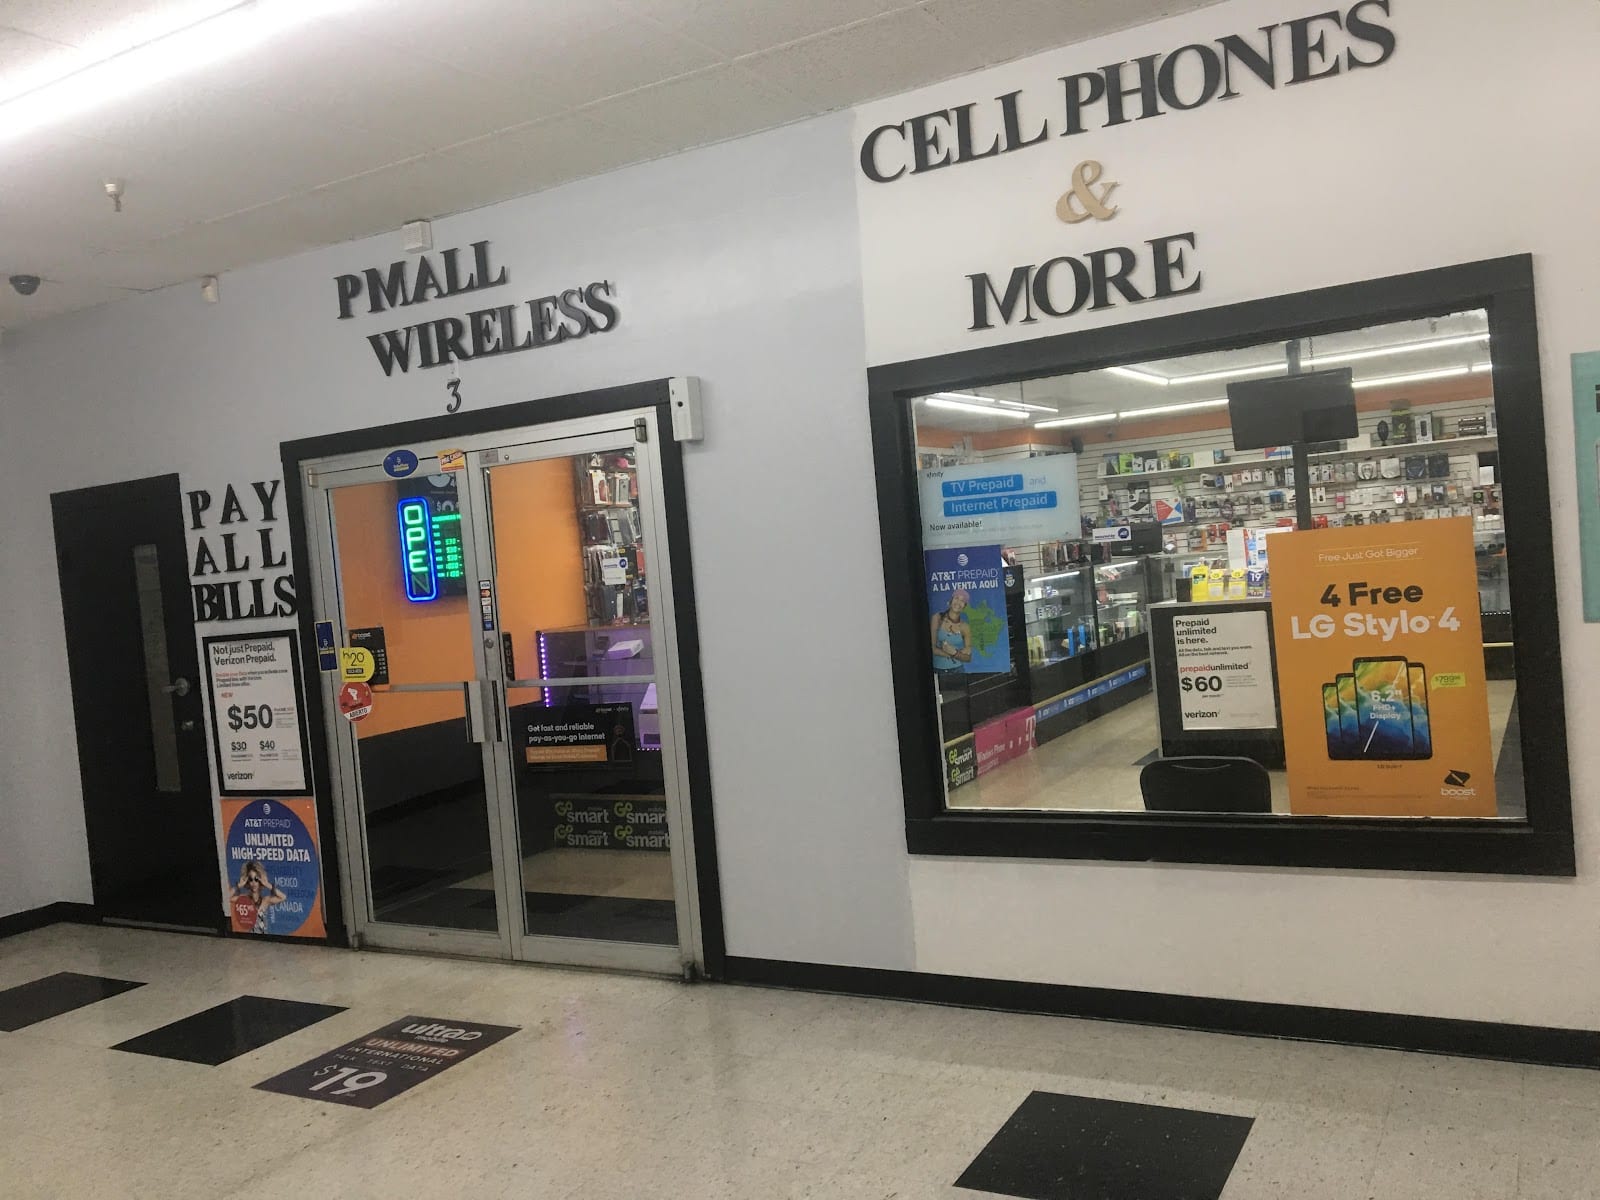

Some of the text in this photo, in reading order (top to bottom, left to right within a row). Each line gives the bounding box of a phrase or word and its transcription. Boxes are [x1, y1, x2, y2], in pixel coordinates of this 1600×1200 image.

[860, 0, 1396, 183] CELL PHONES
[1055, 159, 1120, 224] &
[334, 240, 507, 319] PMALL
[964, 231, 1203, 332] MORE
[366, 279, 619, 376] WIRELESS
[446, 378, 462, 413] 3
[950, 476, 1047, 494] TV Prepaid and
[186, 480, 281, 530] PAY
[951, 493, 1048, 513] Internet Prepaid
[929, 520, 982, 531] Now available!
[192, 528, 287, 576] ALL
[403, 504, 431, 595] OPEN
[1318, 547, 1418, 562] Free Just Got Bigger
[931, 567, 999, 581] AT&T PREPAID
[1250, 573, 1261, 582] 19
[933, 578, 999, 592] A LA VENTA AQUÍ
[191, 574, 299, 622] BILLS
[1320, 582, 1424, 607] 4 Free
[1175, 618, 1209, 627] Prepaid
[1290, 606, 1461, 642] LG Stylo 4
[1176, 627, 1217, 636] unlimited
[1185, 636, 1208, 644] here.
[212, 641, 275, 656] Not just Prepaid.
[214, 653, 277, 666] Verizon Prepaid.
[1179, 663, 1249, 673] prepaidunlimited
[1181, 675, 1222, 692] $60
[227, 704, 273, 732] $50
[1185, 710, 1218, 719] verizon
[1369, 711, 1401, 720] Display
[541, 724, 554, 732] fast
[569, 722, 595, 730] reliable
[231, 740, 275, 751] $30 $40
[528, 735, 578, 744] pay-as-you-go
[226, 771, 253, 780] verizon
[1440, 787, 1476, 796] boost
[567, 809, 609, 823] smart
[614, 802, 666, 824] Go smar
[244, 818, 291, 828] AT&T PREPAID
[244, 833, 294, 847] UNLIMITED
[567, 832, 609, 846] smart
[614, 825, 633, 840] Go
[232, 846, 311, 862] HIGH-SPEED DATA
[274, 877, 298, 888] MEXICO
[274, 900, 303, 913] CANADA
[349, 1046, 444, 1065] INTERNATIONAL
[365, 1038, 460, 1058] UNLIMITED
[309, 1064, 388, 1095] $19
